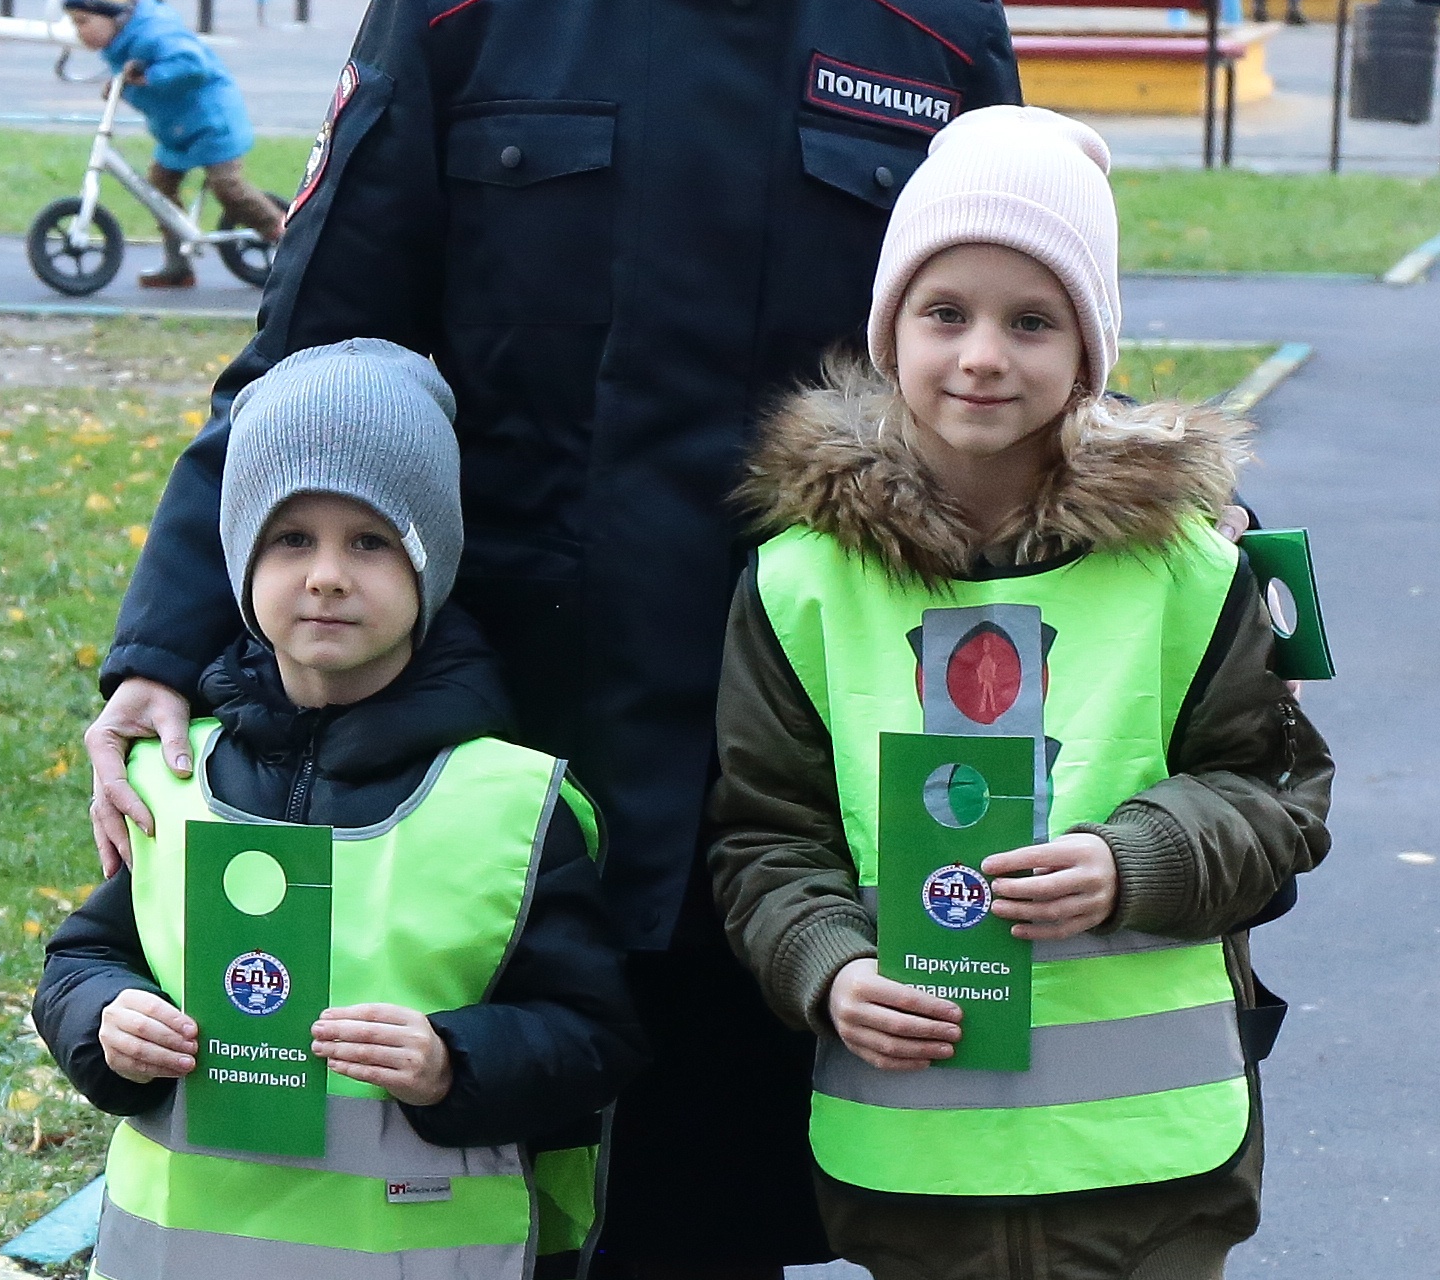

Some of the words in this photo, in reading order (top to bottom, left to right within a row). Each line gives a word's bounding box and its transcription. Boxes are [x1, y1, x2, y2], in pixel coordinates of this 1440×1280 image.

[817, 68, 951, 123] ПОЛИЦИЯ
[905, 954, 1011, 975] Паркуйтесь
[208, 1038, 308, 1062] Паркуйтесь
[208, 1067, 307, 1088] правильно!
